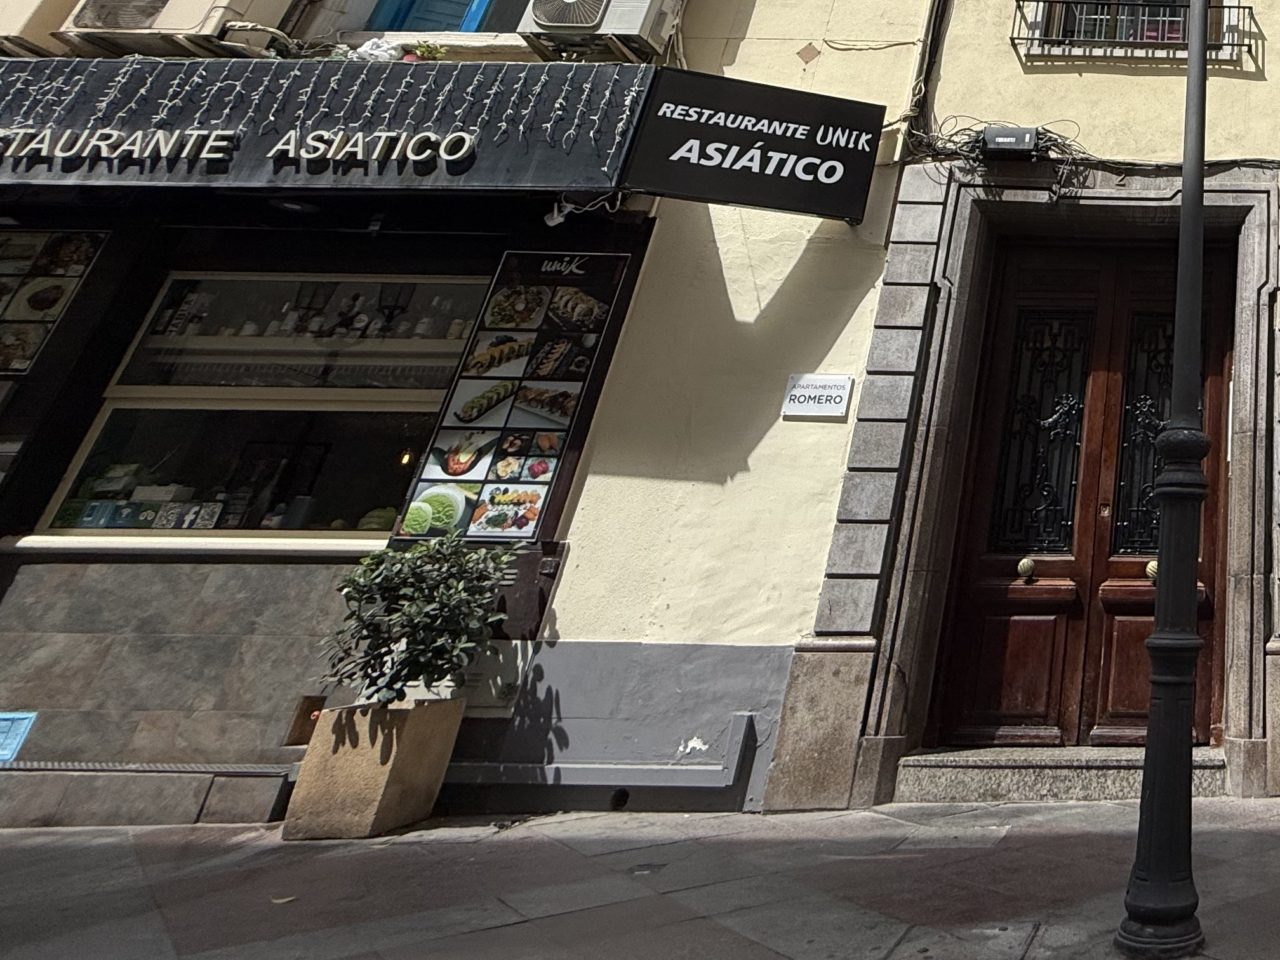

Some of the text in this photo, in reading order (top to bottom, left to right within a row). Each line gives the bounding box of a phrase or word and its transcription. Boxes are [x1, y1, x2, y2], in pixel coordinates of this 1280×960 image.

[0, 128, 474, 161] TAURANTE ASIATICO
[657, 102, 872, 152] RESTAURANTE UNIK
[668, 139, 845, 184] ASIÁTICO
[788, 394, 844, 405] ROMERO
